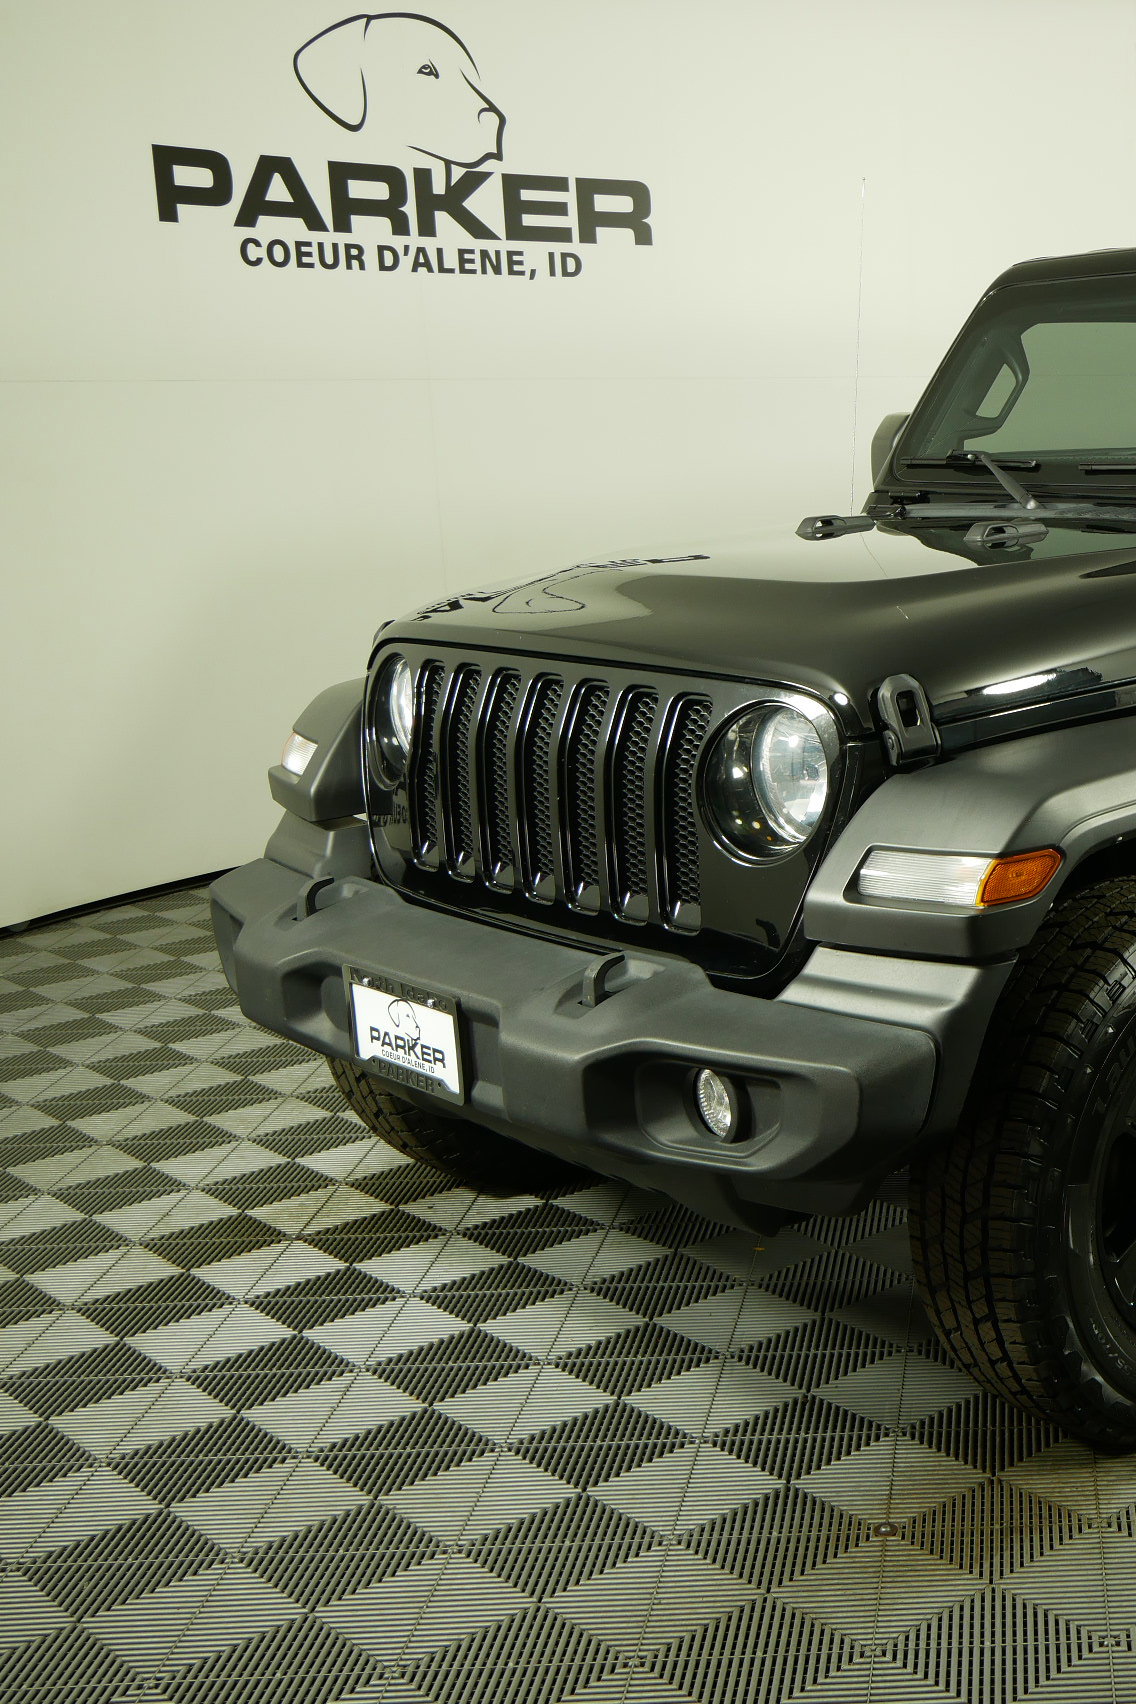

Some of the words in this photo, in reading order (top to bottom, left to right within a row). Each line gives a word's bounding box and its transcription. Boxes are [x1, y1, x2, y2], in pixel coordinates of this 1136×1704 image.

[152, 144, 653, 246] PARKER
[240, 238, 366, 271] COEUR
[377, 245, 537, 281] D'ALENE,
[549, 252, 582, 278] ID
[369, 1025, 447, 1069] PARKER
[381, 1049, 401, 1062] COEUR
[401, 1056, 428, 1073] D'ALENE,
[428, 1065, 435, 1074] ID
[378, 1060, 435, 1093] PARKER
